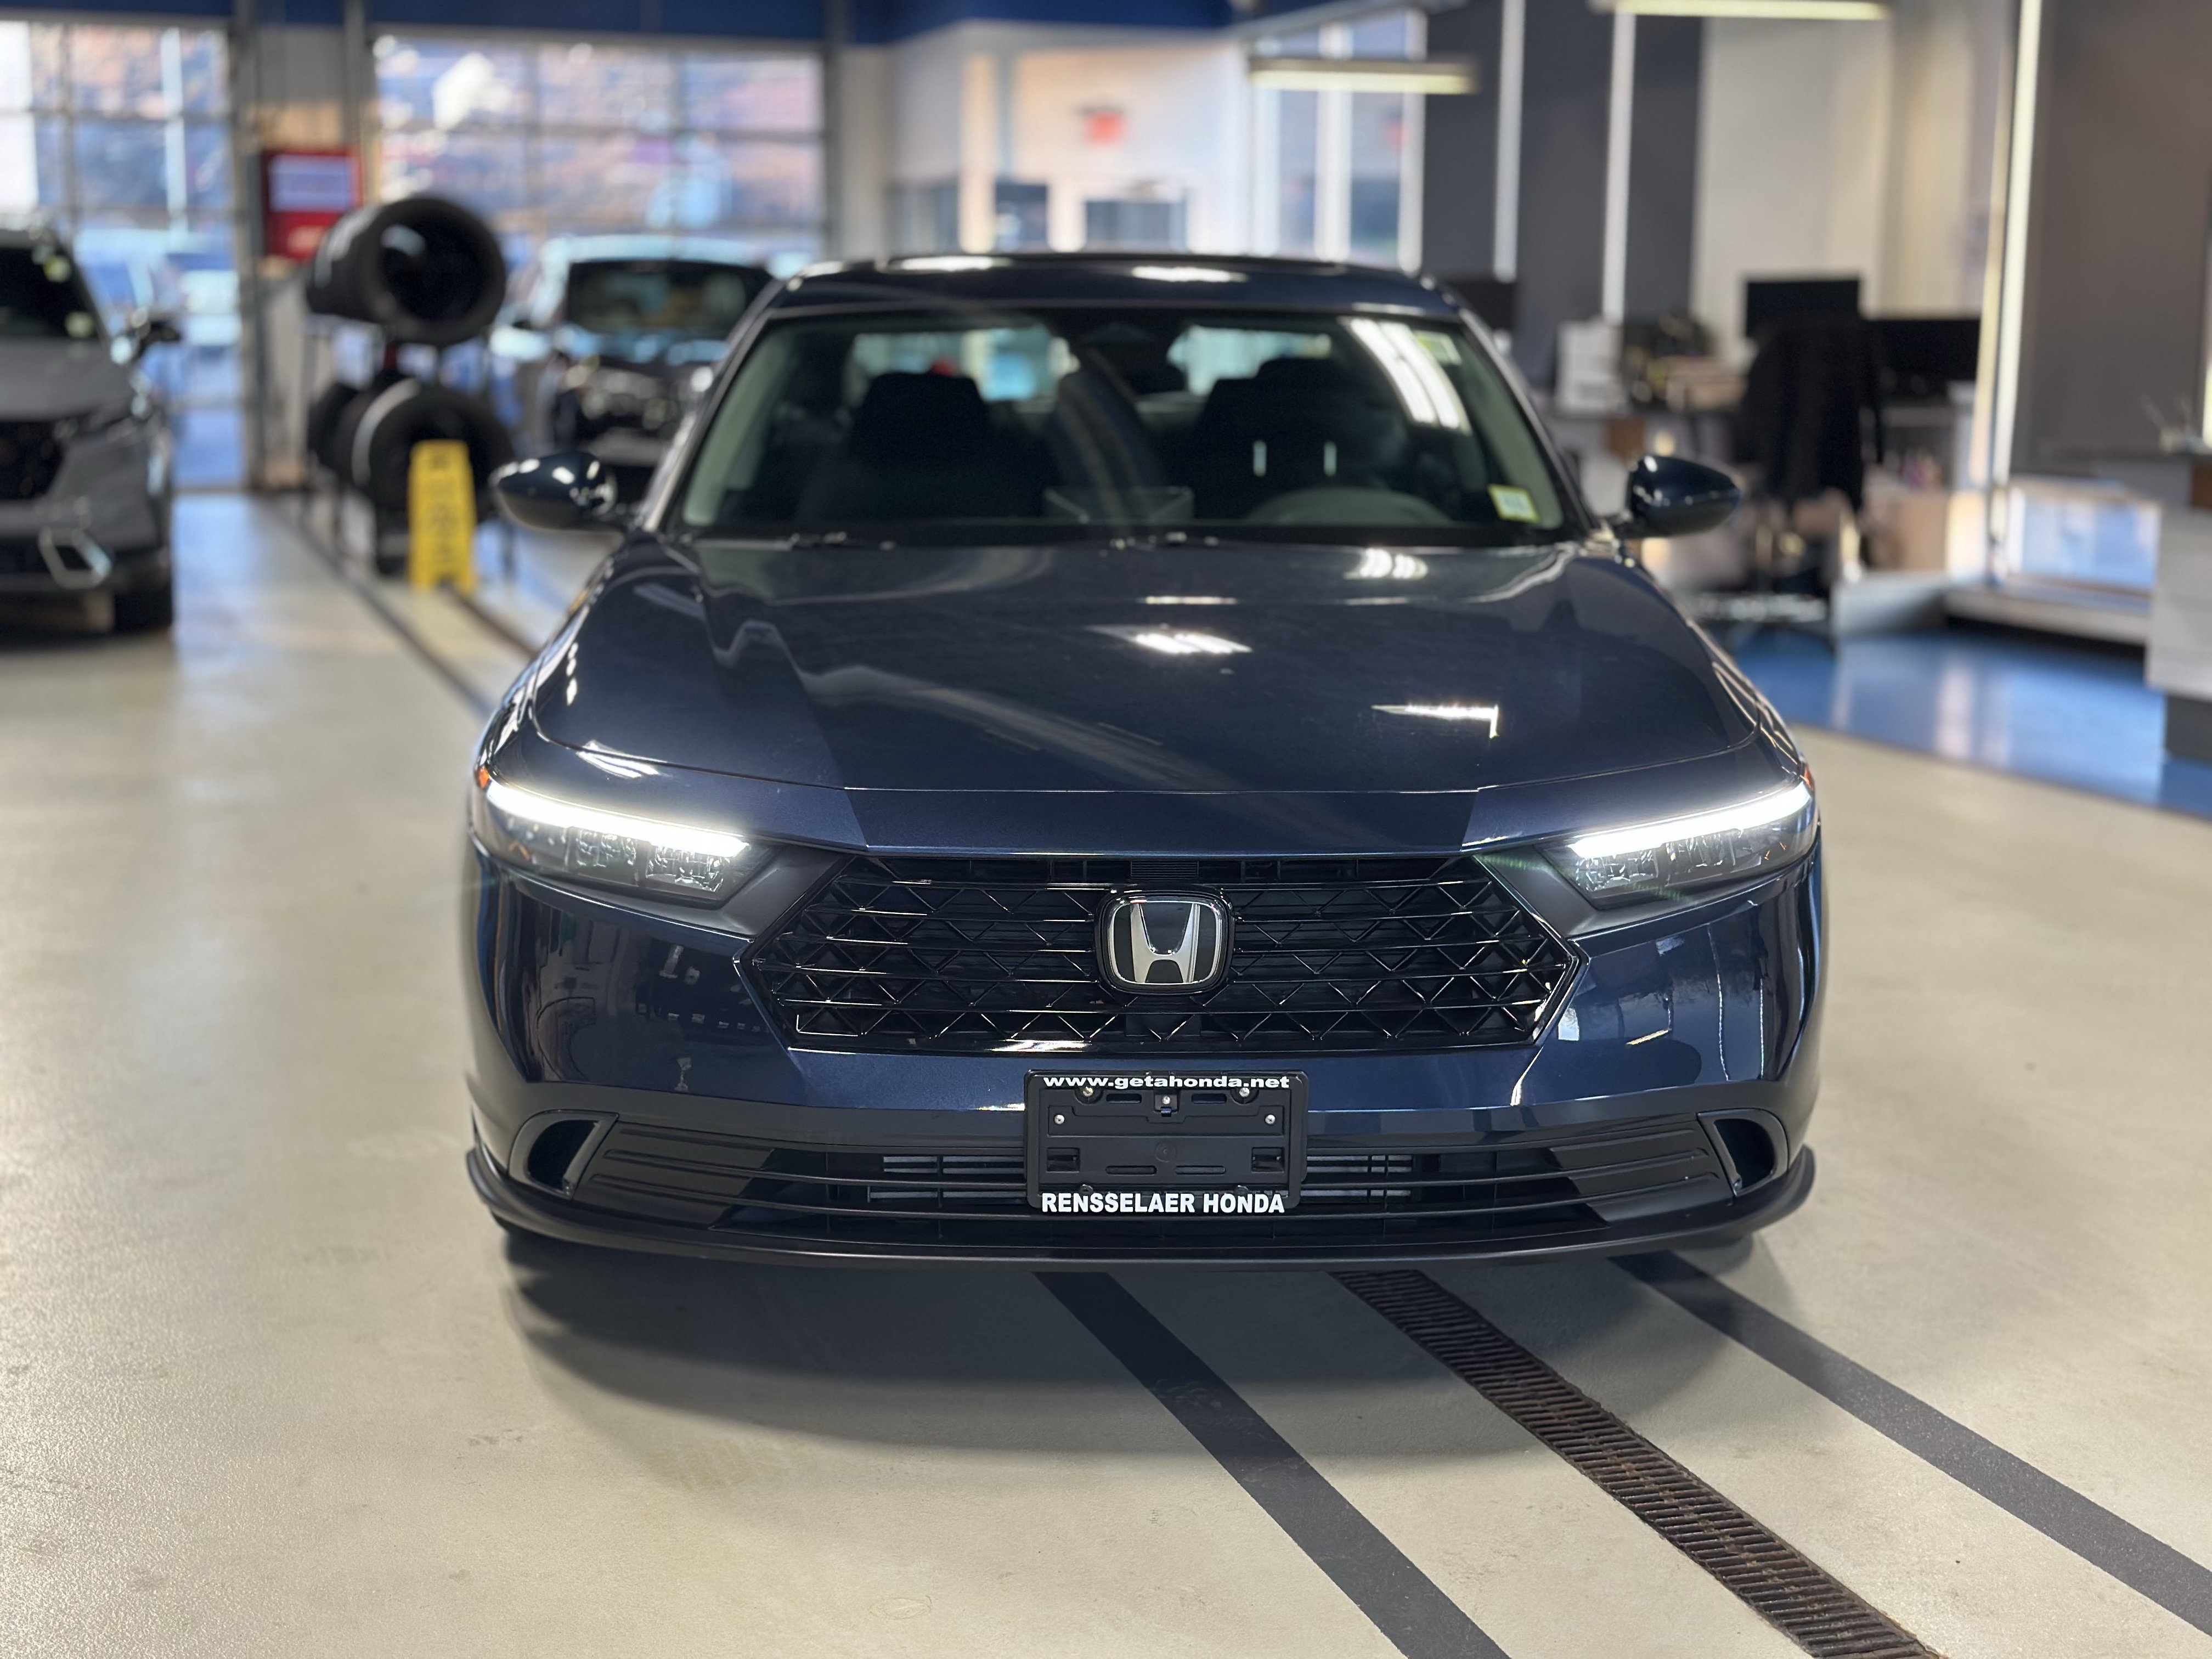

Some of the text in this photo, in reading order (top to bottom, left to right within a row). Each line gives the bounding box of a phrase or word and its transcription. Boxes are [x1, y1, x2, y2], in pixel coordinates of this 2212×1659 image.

[1043, 1076, 1290, 1090] www.getahonda.net
[1042, 1193, 1285, 1213] RENSSELAER HONDA
